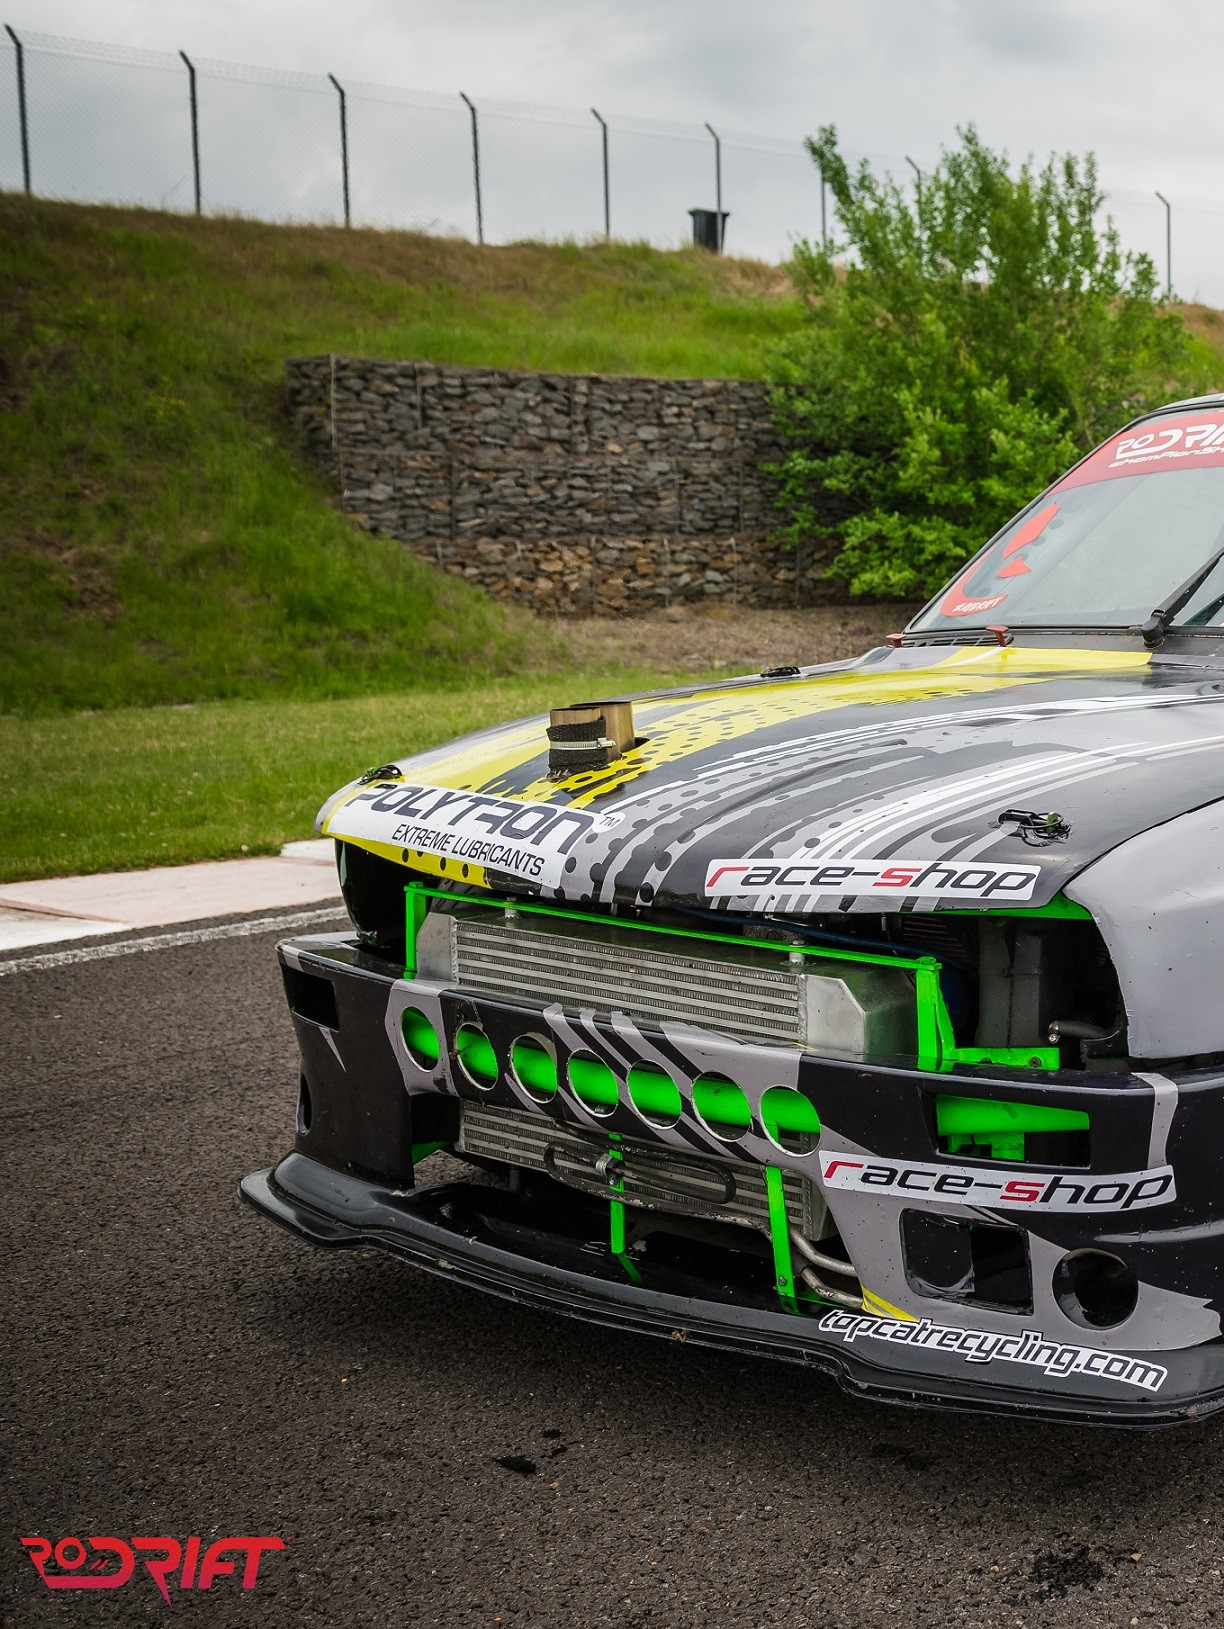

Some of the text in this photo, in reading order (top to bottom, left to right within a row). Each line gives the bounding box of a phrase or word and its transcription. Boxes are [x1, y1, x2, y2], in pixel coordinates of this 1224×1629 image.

[344, 783, 594, 855] POLYTRON
[391, 824, 545, 877] EXTREME LUBRICANTS
[706, 862, 1037, 897] race-shop
[824, 1160, 1174, 1209] race-shop
[818, 1310, 1168, 1391] topcatrecycling.com
